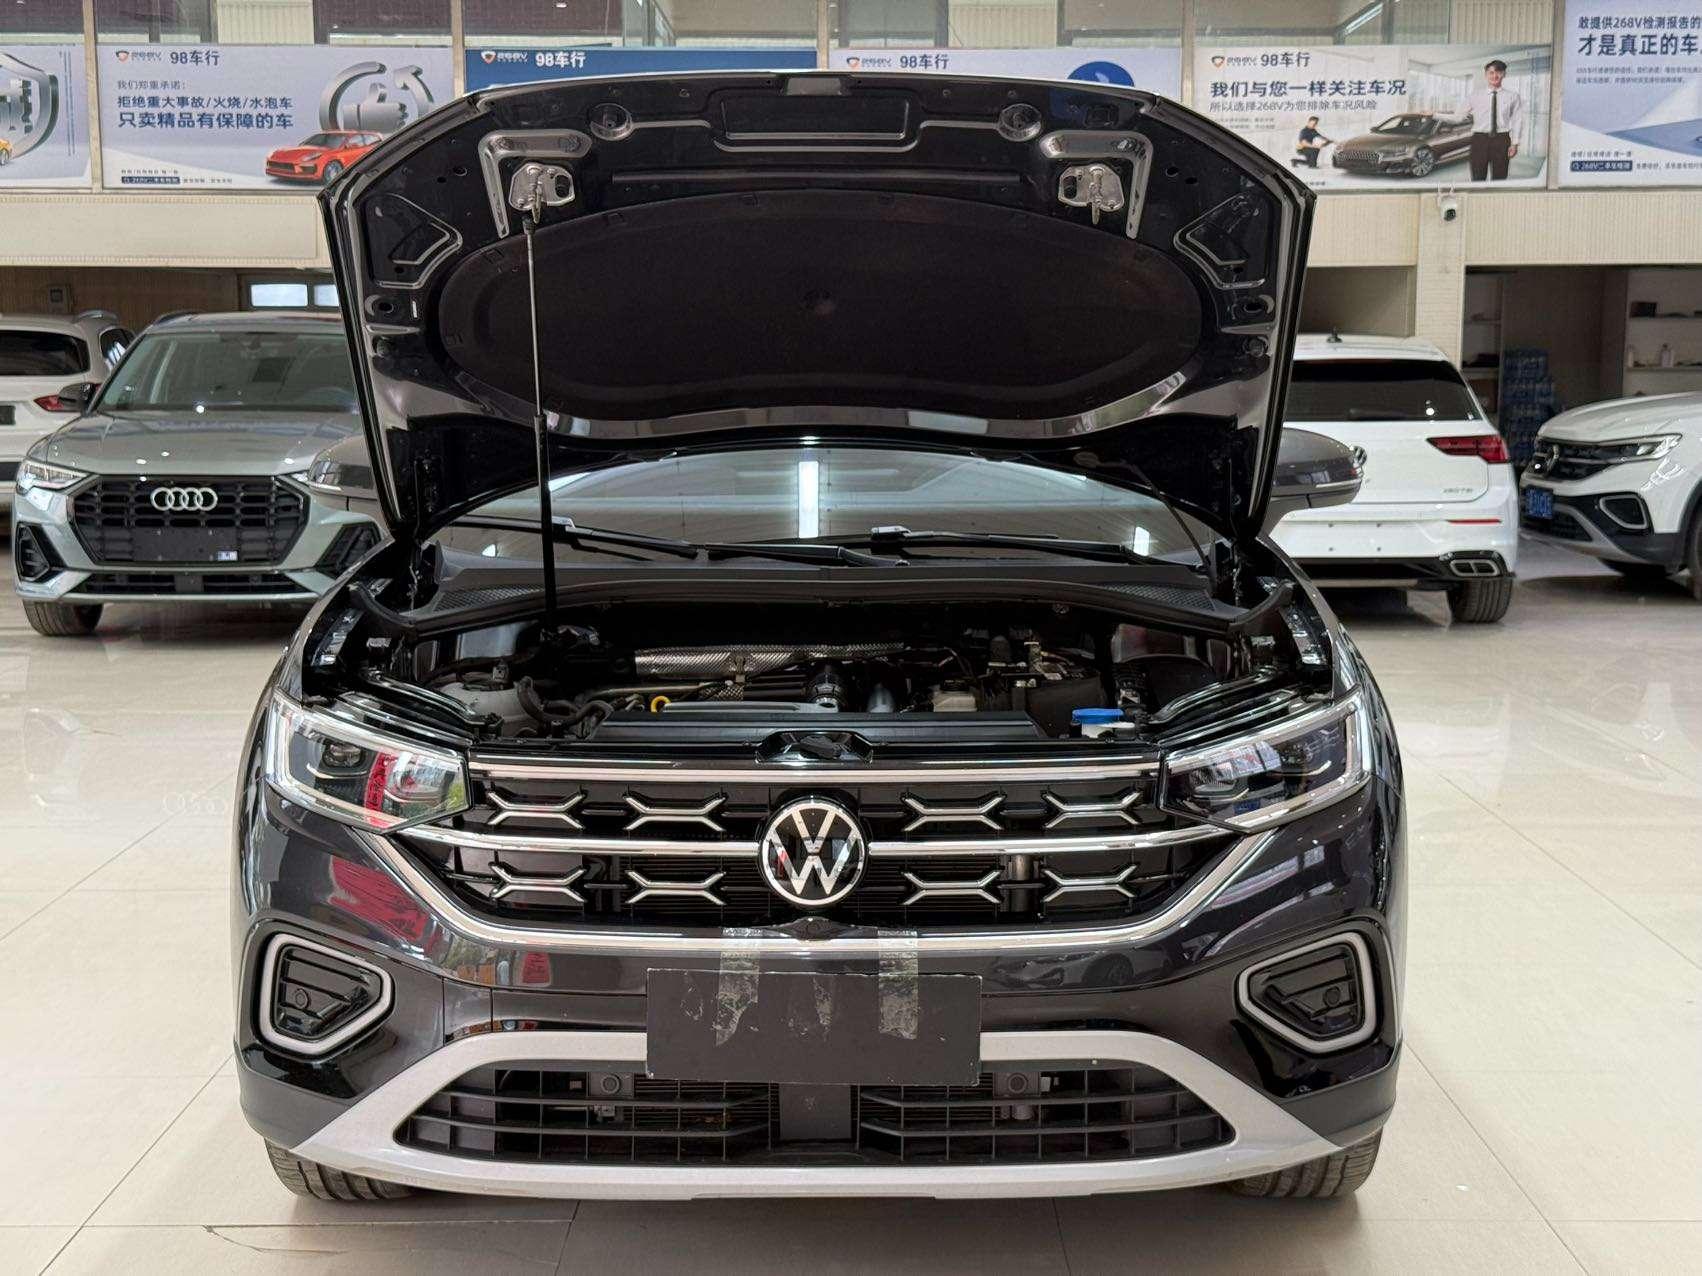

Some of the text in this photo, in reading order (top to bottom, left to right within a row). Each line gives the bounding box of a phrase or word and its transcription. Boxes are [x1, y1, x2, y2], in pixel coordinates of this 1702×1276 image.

[170, 51, 220, 66] 98车行
[535, 51, 586, 68] 98车行
[900, 54, 949, 69] 98车行
[1260, 52, 1311, 67] 98车行
[1210, 80, 1407, 97] 我们与您一样关注车况
[117, 96, 293, 109] 拒绝重大事故/火烧/水泡车
[118, 112, 294, 129] 只卖精品有保障的车
